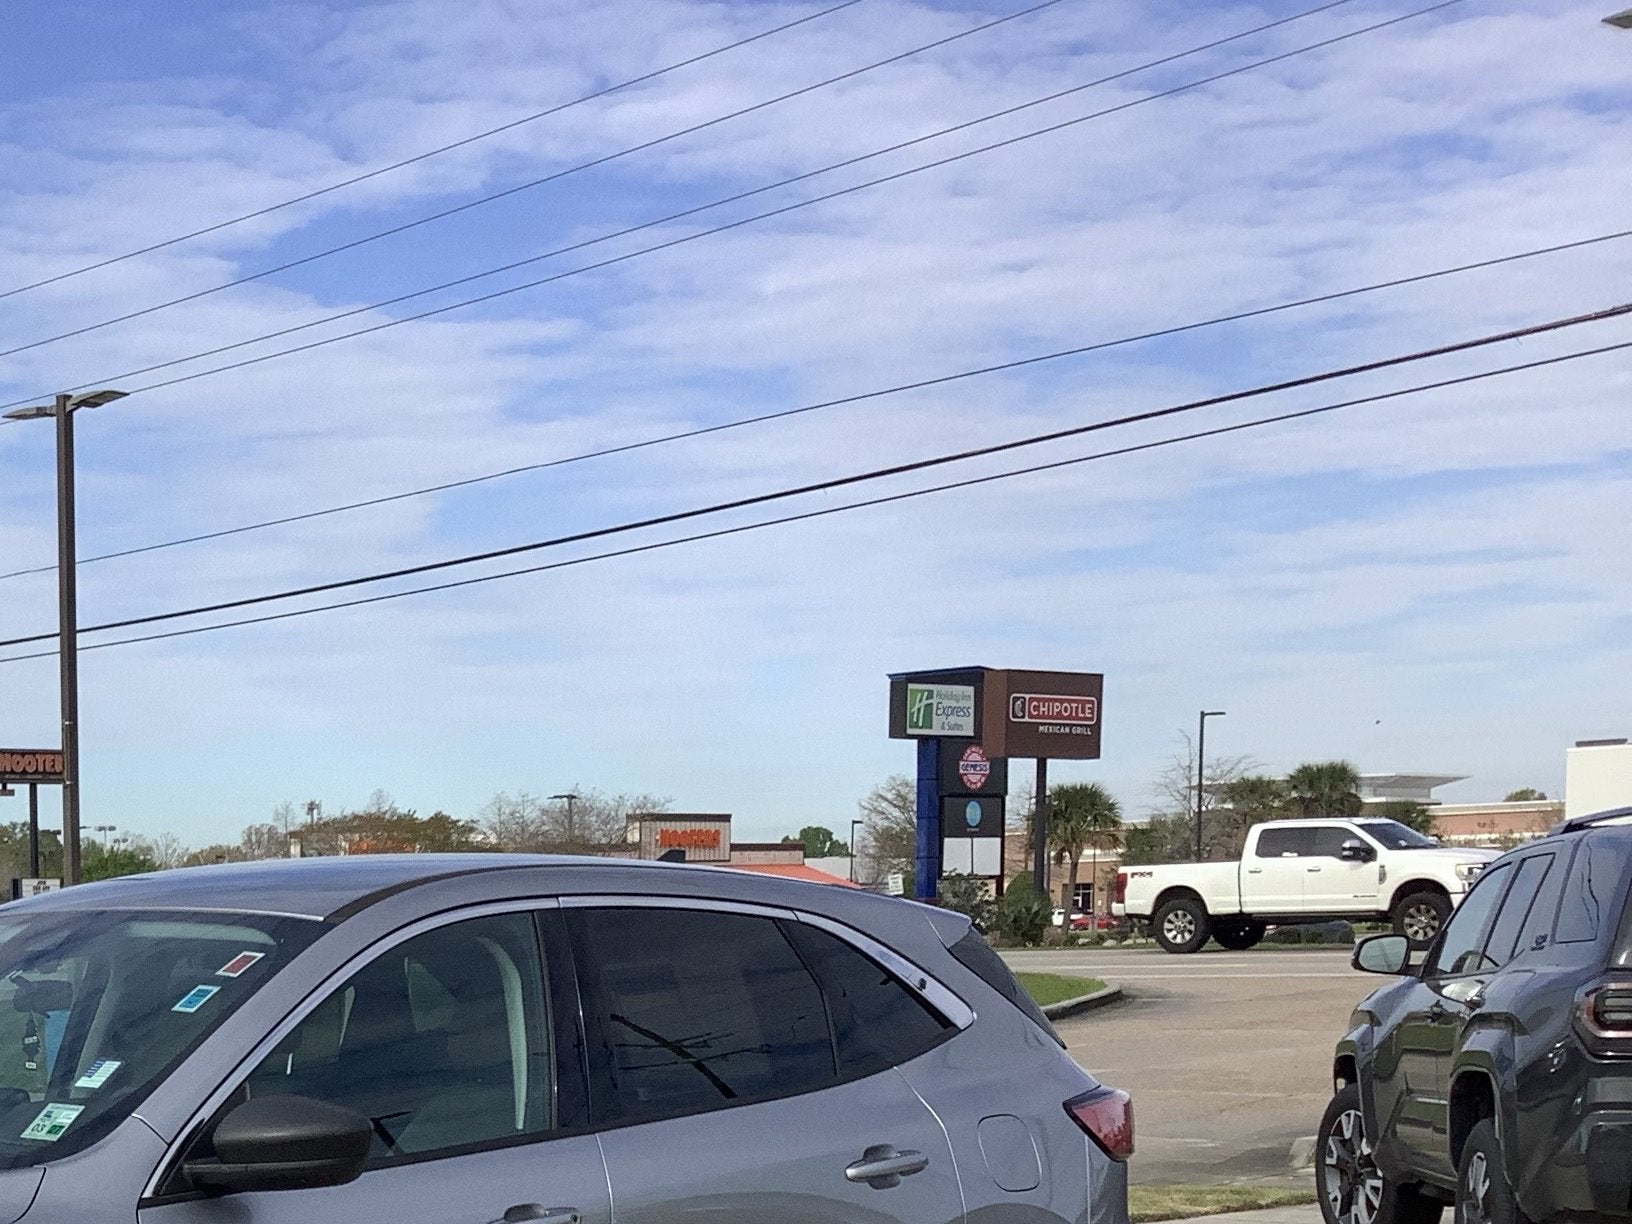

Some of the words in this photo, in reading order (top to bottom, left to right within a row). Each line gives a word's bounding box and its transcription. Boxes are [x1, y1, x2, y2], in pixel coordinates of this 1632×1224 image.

[935, 701, 971, 720] Express
[1030, 701, 1093, 718] CHIPOTLE
[1038, 725, 1070, 734] MEXICAN
[1071, 726, 1092, 735] GRILL
